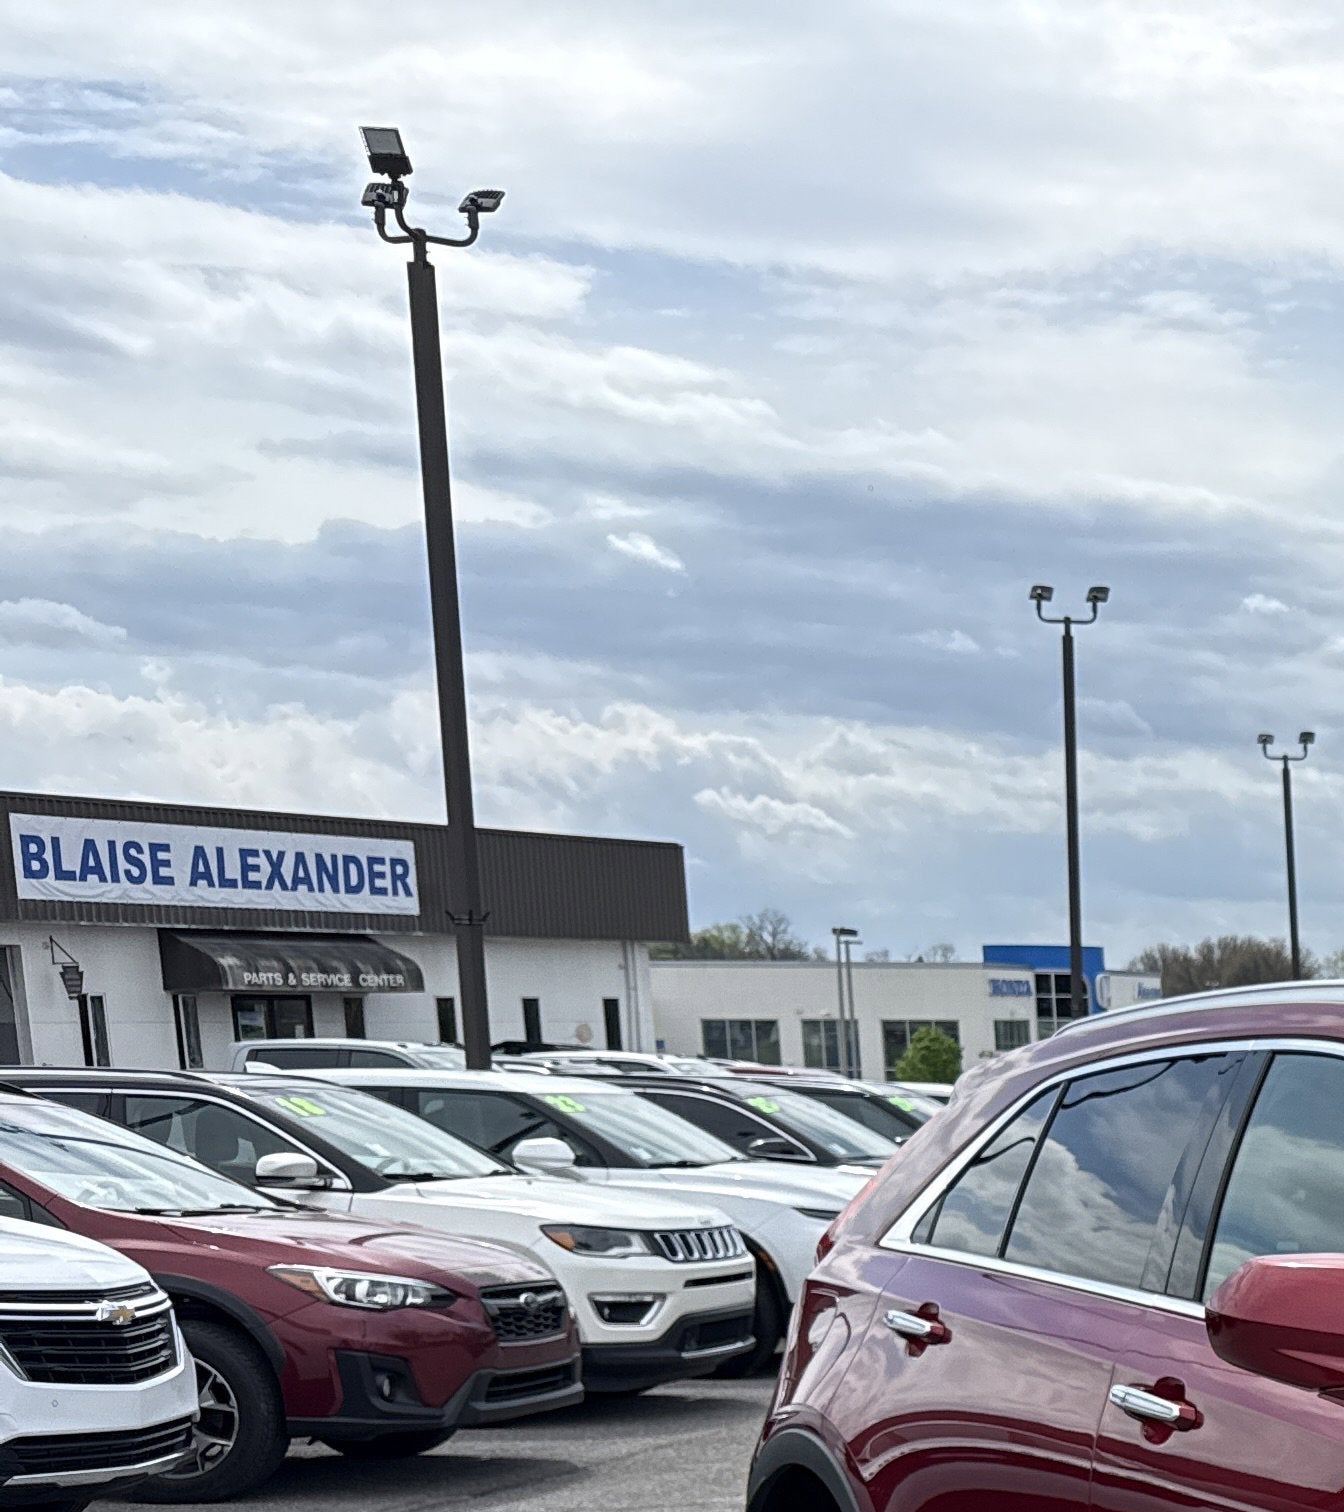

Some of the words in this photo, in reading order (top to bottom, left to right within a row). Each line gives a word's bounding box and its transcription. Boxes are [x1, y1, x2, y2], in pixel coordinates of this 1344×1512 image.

[19, 833, 176, 886] BLAISE
[188, 844, 414, 898] ALEXANDER
[243, 972, 284, 986] PARTS
[287, 973, 297, 986] &
[301, 972, 353, 987] SERVICE
[358, 973, 405, 987] CENTER
